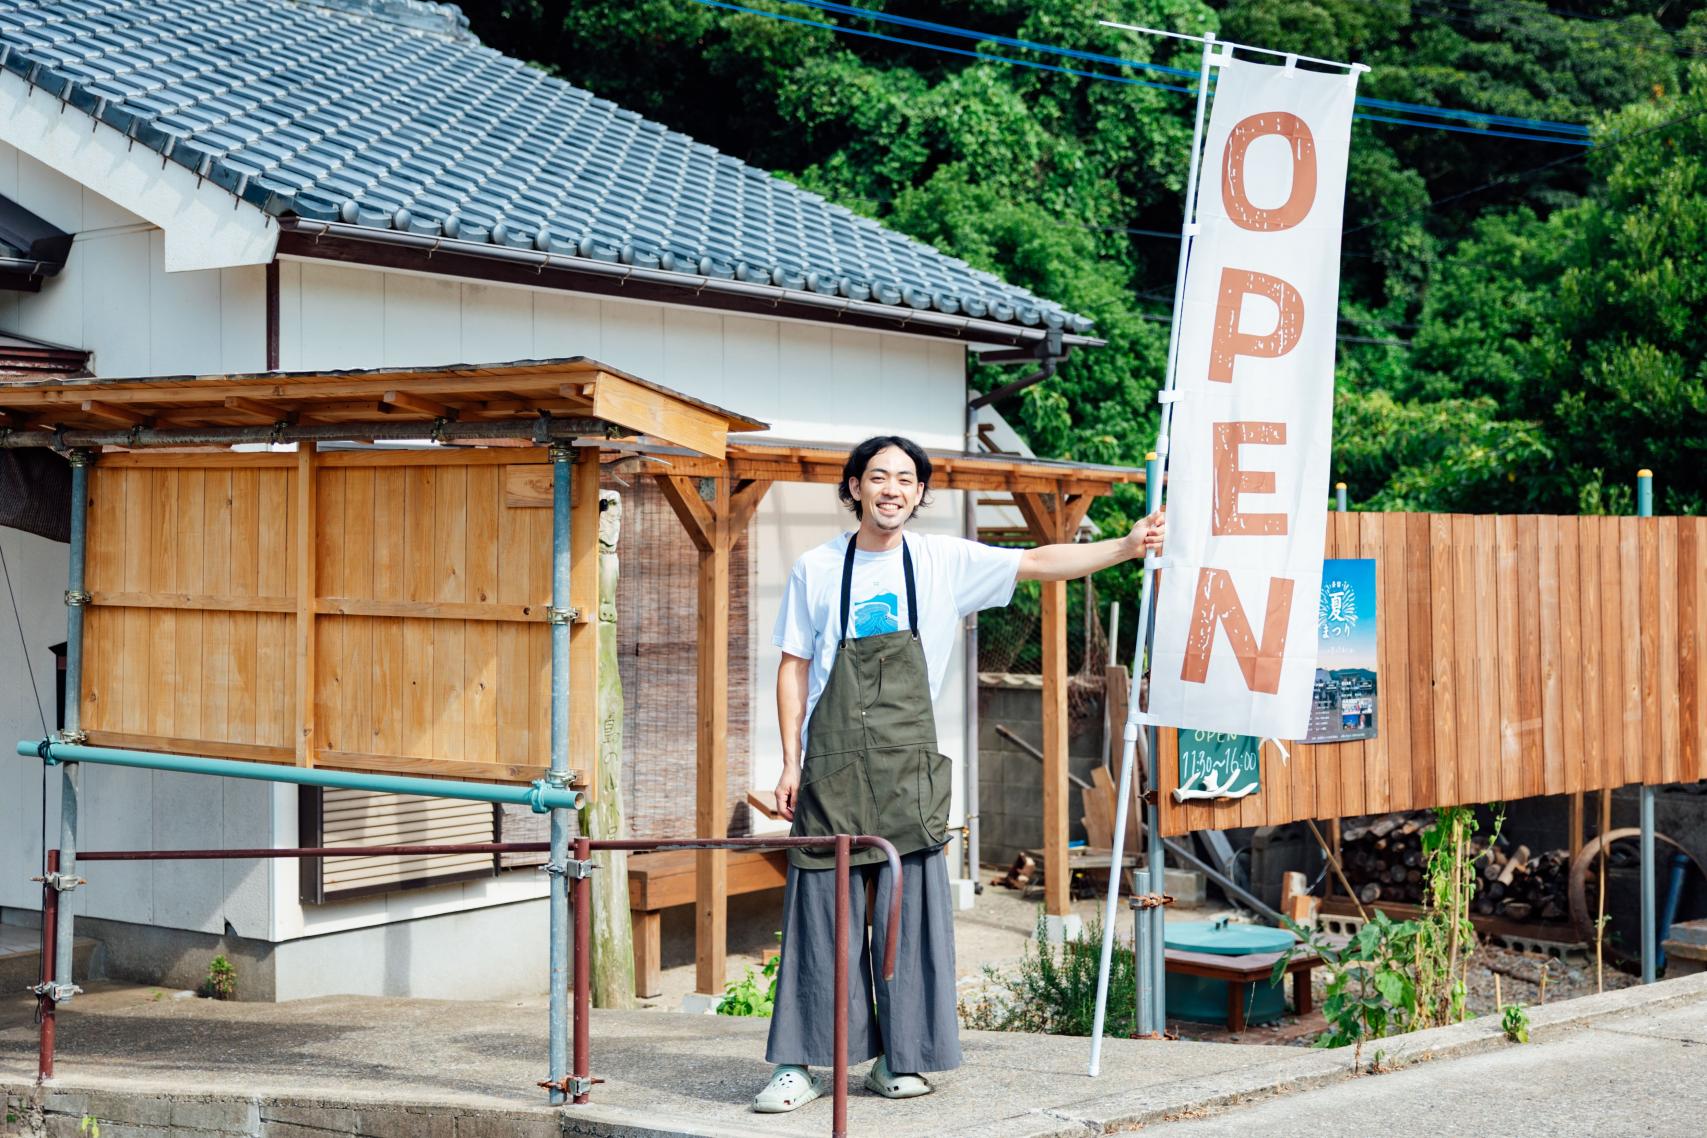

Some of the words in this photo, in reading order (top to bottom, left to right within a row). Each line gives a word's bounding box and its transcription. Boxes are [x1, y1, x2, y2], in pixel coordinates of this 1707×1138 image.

[1180, 111, 1317, 695] OPEN
[1328, 591, 1346, 622] 夏
[1322, 622, 1350, 639] まつり
